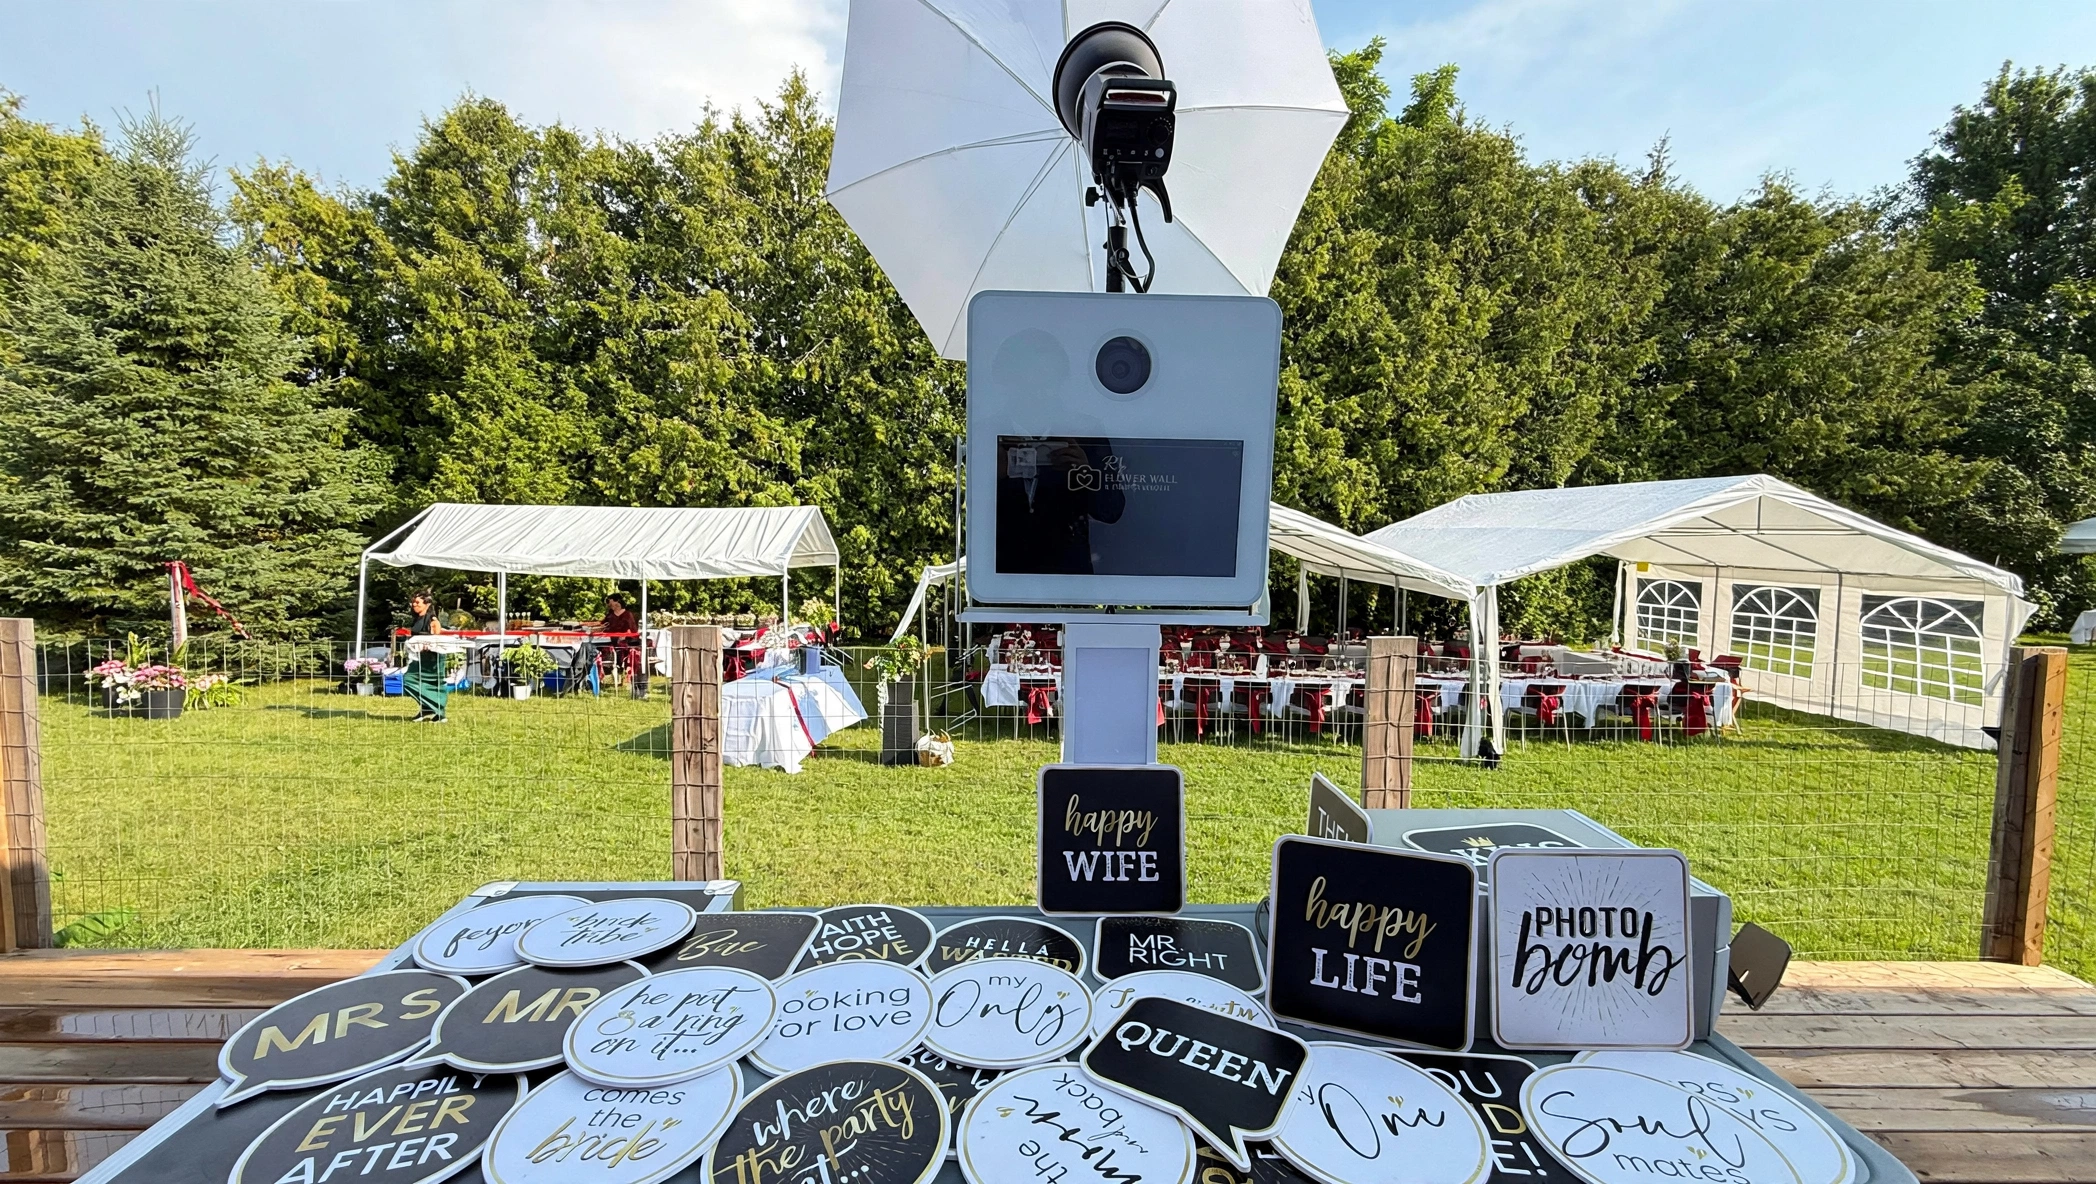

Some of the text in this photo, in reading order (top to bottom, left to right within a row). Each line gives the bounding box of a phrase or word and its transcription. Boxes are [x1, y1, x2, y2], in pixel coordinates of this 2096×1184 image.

[1149, 474, 1178, 484] WALL
[1065, 794, 1158, 847] happy
[1063, 851, 1160, 882] WIFE
[572, 911, 662, 929] bride
[820, 911, 893, 939] AITH
[1305, 876, 1437, 959] happy
[1535, 906, 1639, 938] PHOTO
[809, 925, 902, 959] HOPE
[965, 936, 1050, 956] HELLA
[1129, 932, 1184, 951] MR.
[1129, 947, 1229, 971] RIGHT
[1512, 910, 1687, 996] bomb
[988, 975, 1028, 989] my
[1309, 947, 1422, 1004] LIFE
[482, 987, 601, 1024] MR
[620, 984, 761, 1017] he put
[782, 987, 911, 1014] ooking
[935, 979, 1082, 1046] Only
[253, 988, 442, 1060] MRS
[637, 1013, 748, 1046] a ring
[774, 1010, 912, 1038] or love
[590, 1037, 641, 1056] on
[1115, 1021, 1292, 1096] QUEEN
[323, 1073, 488, 1114] HAPPILY
[584, 1088, 687, 1106] comes
[1052, 1073, 1123, 1129] back
[295, 1094, 476, 1152] EVER
[587, 1107, 643, 1128] the
[753, 1079, 864, 1146] where
[1318, 1082, 1445, 1160] One
[1540, 1090, 1746, 1169] Soul
[525, 1116, 668, 1168] bride
[713, 1139, 806, 1184] the
[819, 1077, 916, 1171] party
[272, 1133, 459, 1184] AFTER
[1018, 1139, 1068, 1184] the
[1612, 1153, 1751, 1184] mates
